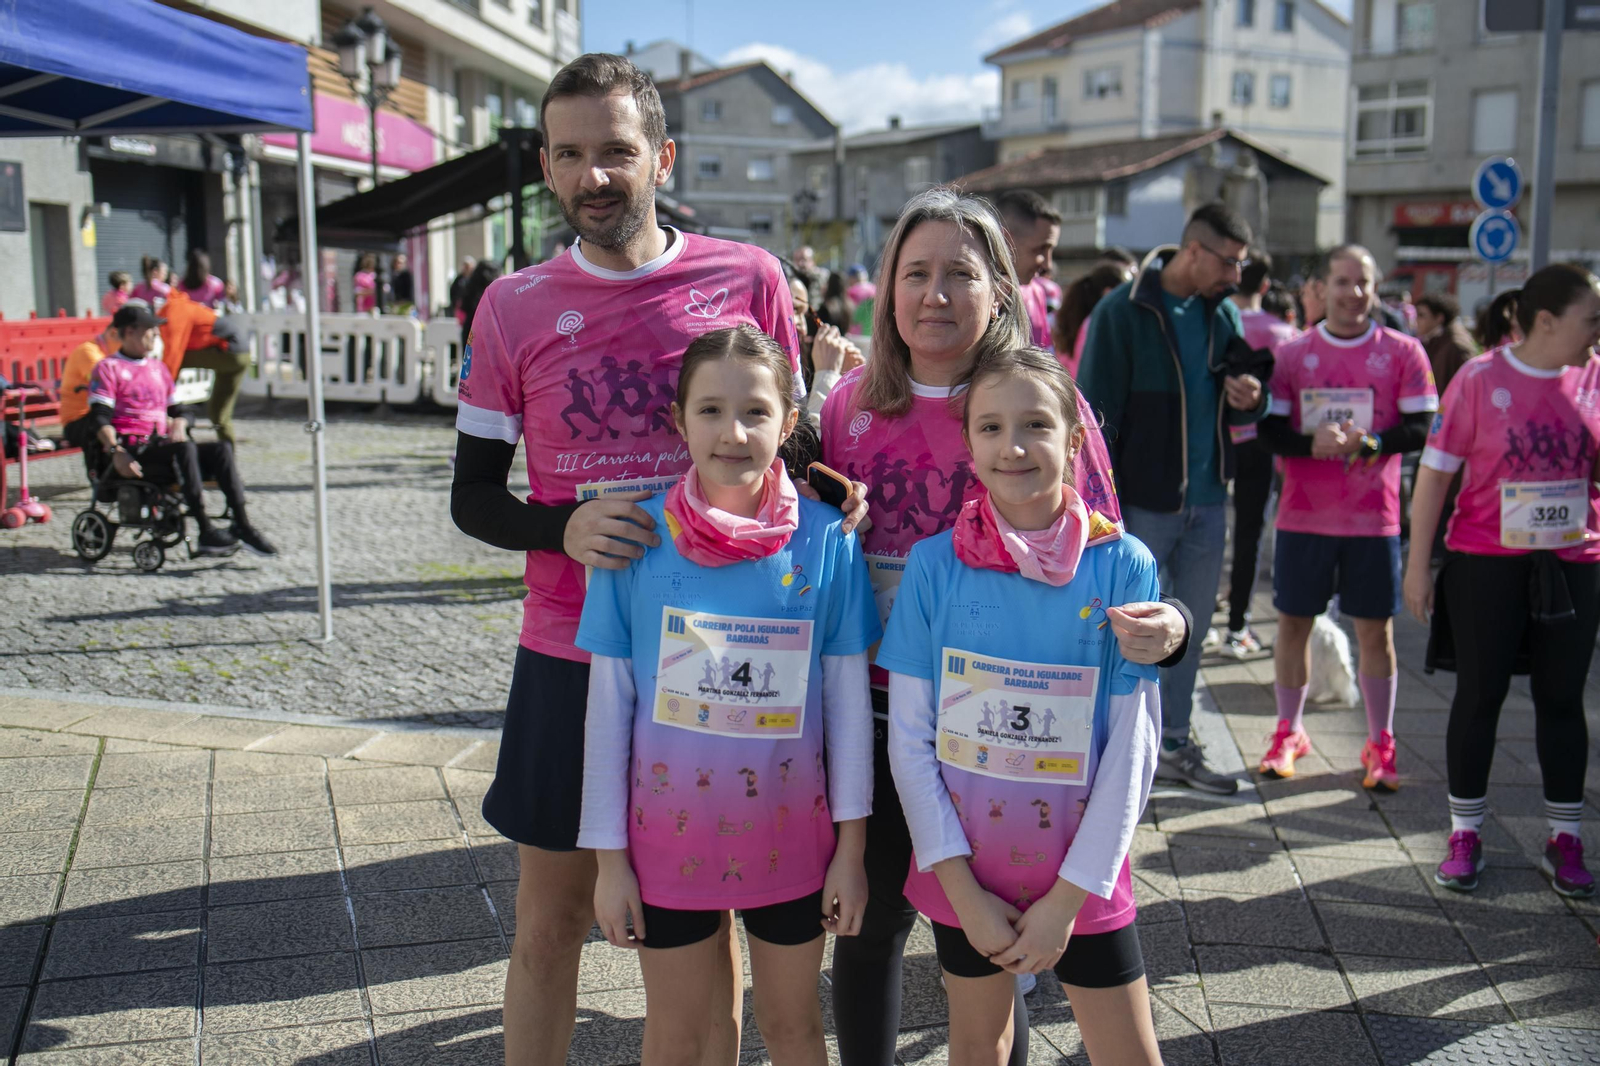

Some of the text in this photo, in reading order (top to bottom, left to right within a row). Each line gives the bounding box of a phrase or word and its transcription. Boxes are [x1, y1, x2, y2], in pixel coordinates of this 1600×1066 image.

[555, 444, 690, 472] III Carreira pola
[1535, 505, 1569, 521] 320
[668, 614, 801, 635] III CARREIRA POLA IGUALDADE
[726, 633, 770, 645] BARBADÁS
[731, 662, 752, 687] 4
[948, 655, 1082, 681] III CARREIRA POLA IGUALDADE
[698, 686, 721, 695] MARTINA
[1004, 677, 1050, 690] BARBADÁS
[1010, 705, 1031, 731] 3
[977, 728, 999, 738] DANIELA
